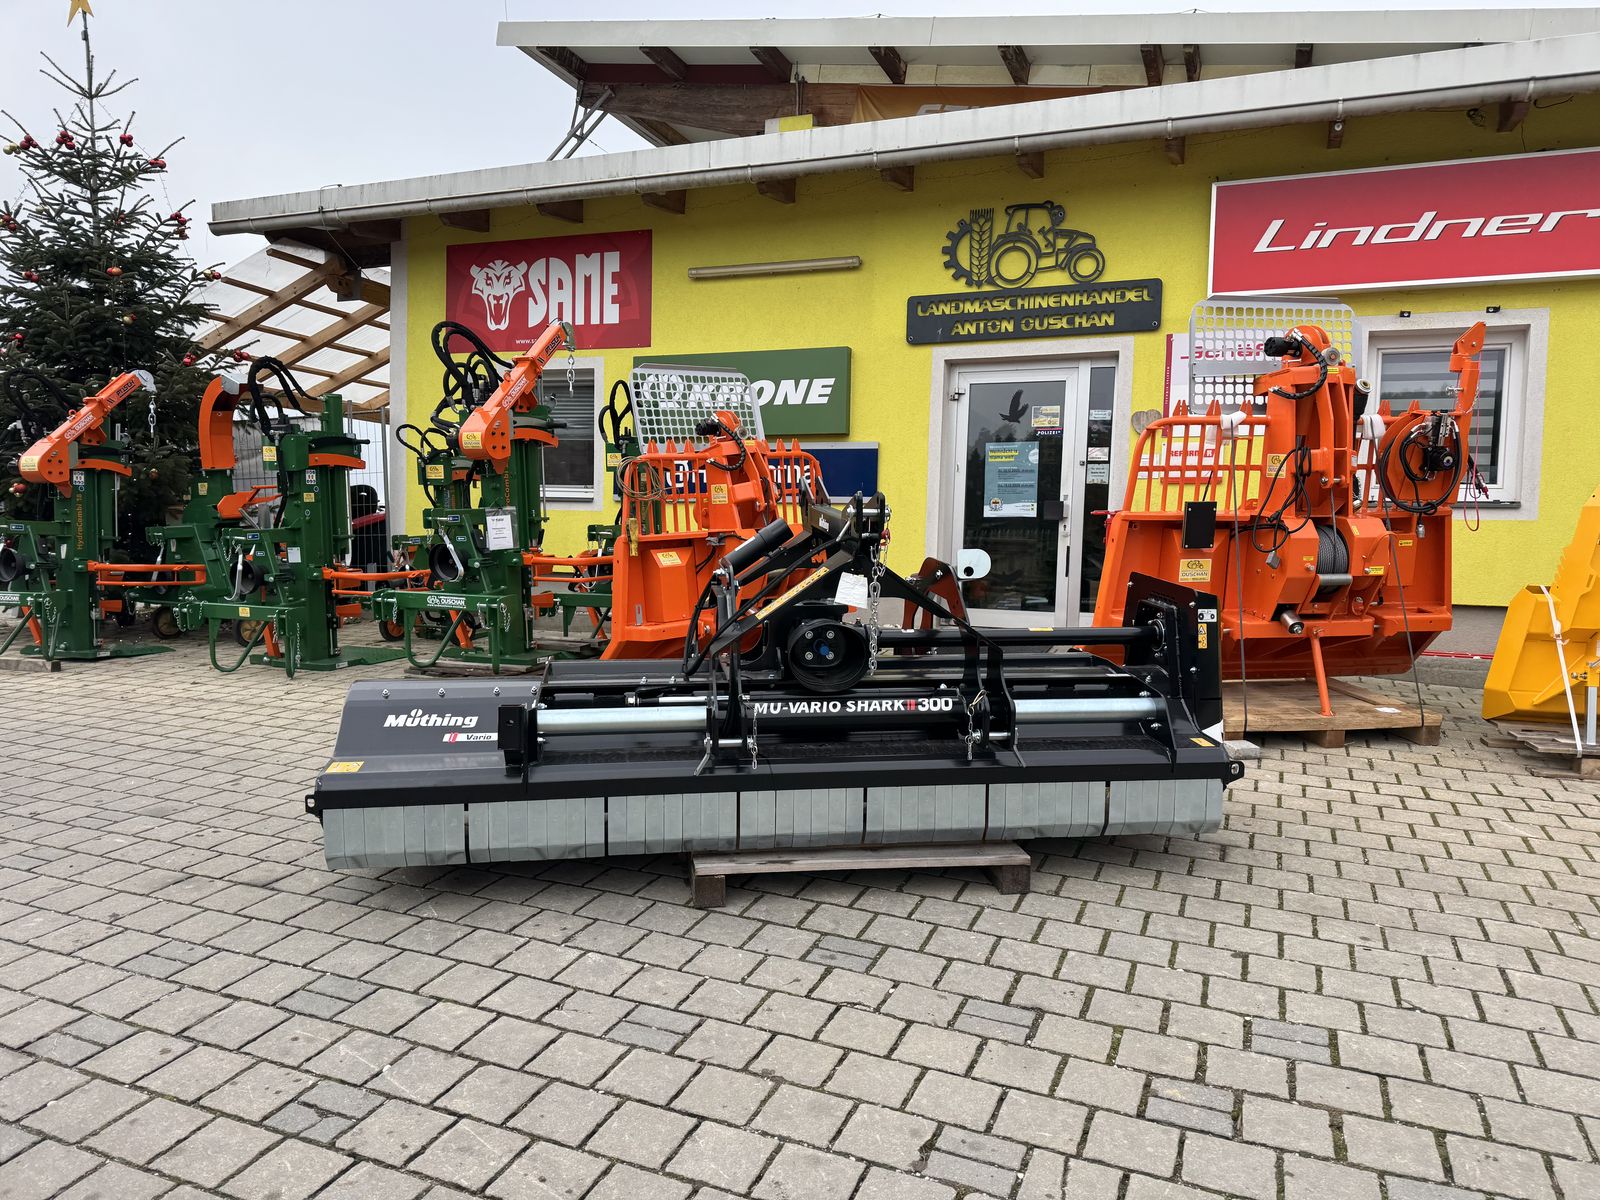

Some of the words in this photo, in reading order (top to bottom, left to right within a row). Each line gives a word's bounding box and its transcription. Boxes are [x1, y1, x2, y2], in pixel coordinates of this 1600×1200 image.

[1253, 206, 1600, 252] Lindner
[528, 250, 620, 329] SAME
[916, 286, 1155, 317] LANDMASCHINENHANDEL
[951, 318, 1015, 336] ANTON
[1020, 311, 1115, 332] OUSCHAN
[383, 708, 479, 729] Müthing
[753, 700, 841, 715] MU-VARIO
[845, 699, 905, 713] SHARK
[917, 697, 953, 712] 300
